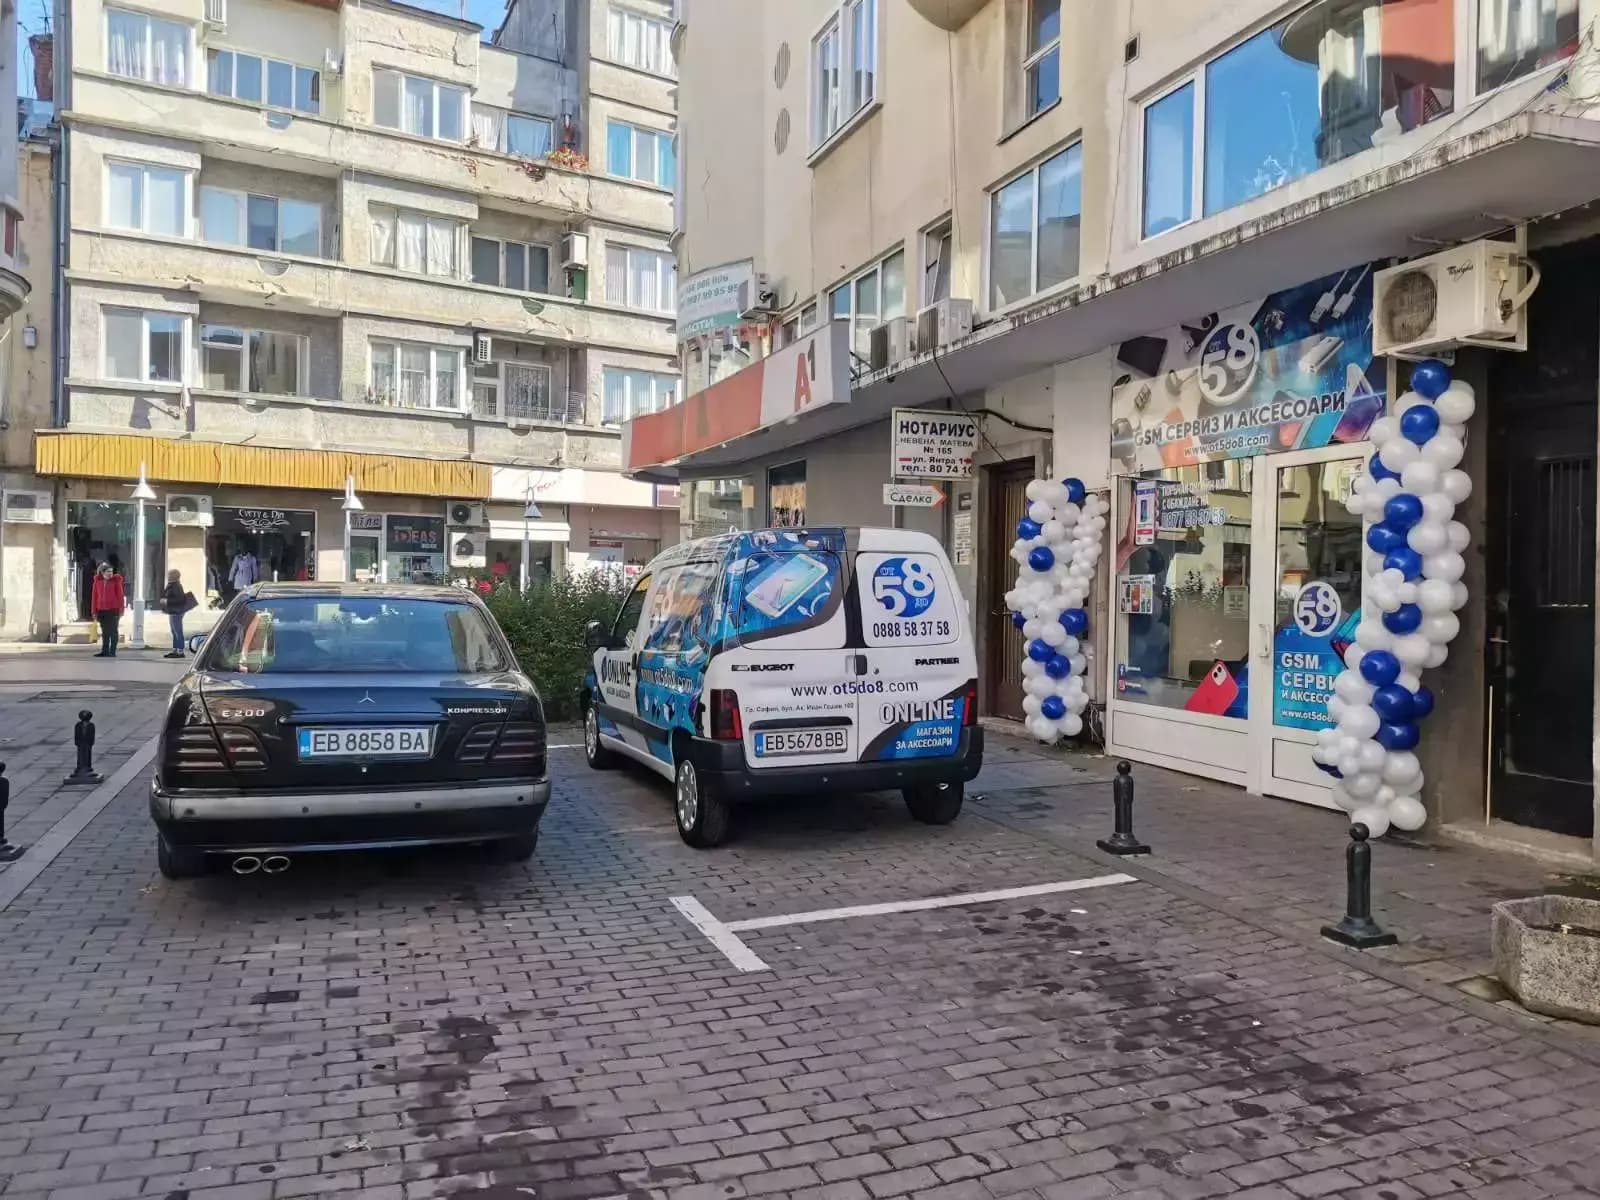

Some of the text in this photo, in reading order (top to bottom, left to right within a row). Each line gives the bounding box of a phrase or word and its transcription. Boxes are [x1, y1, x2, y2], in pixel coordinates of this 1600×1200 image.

[794, 339, 816, 413] A1
[1134, 391, 1346, 447] GSM СЕРВИЗ И АКСЕСОАРИ
[900, 420, 975, 438] НОТАРИУС
[937, 447, 952, 455] 165
[912, 457, 927, 465] ул.
[929, 456, 956, 465] Янтра
[929, 465, 942, 473] 80
[946, 465, 958, 474] 74
[890, 492, 932, 504] Сделка
[874, 557, 935, 617] 58
[873, 620, 950, 638] 0888 58 37 58
[915, 657, 960, 666] PARTNER
[1281, 652, 1320, 670] GSM
[791, 680, 919, 697] www.ot5do8.com
[1281, 671, 1336, 691] СЕРВИ
[1290, 690, 1331, 704] АКСЕСО
[222, 709, 265, 718] E 200
[447, 707, 507, 715] KOMPRESSOR
[879, 698, 955, 725] ONLINE
[916, 725, 953, 737] МАГАЗИН
[313, 731, 425, 752] EB 8858 BA
[787, 733, 823, 750] 5678
[895, 737, 953, 750] ЗА АКСЕСОАРИ
